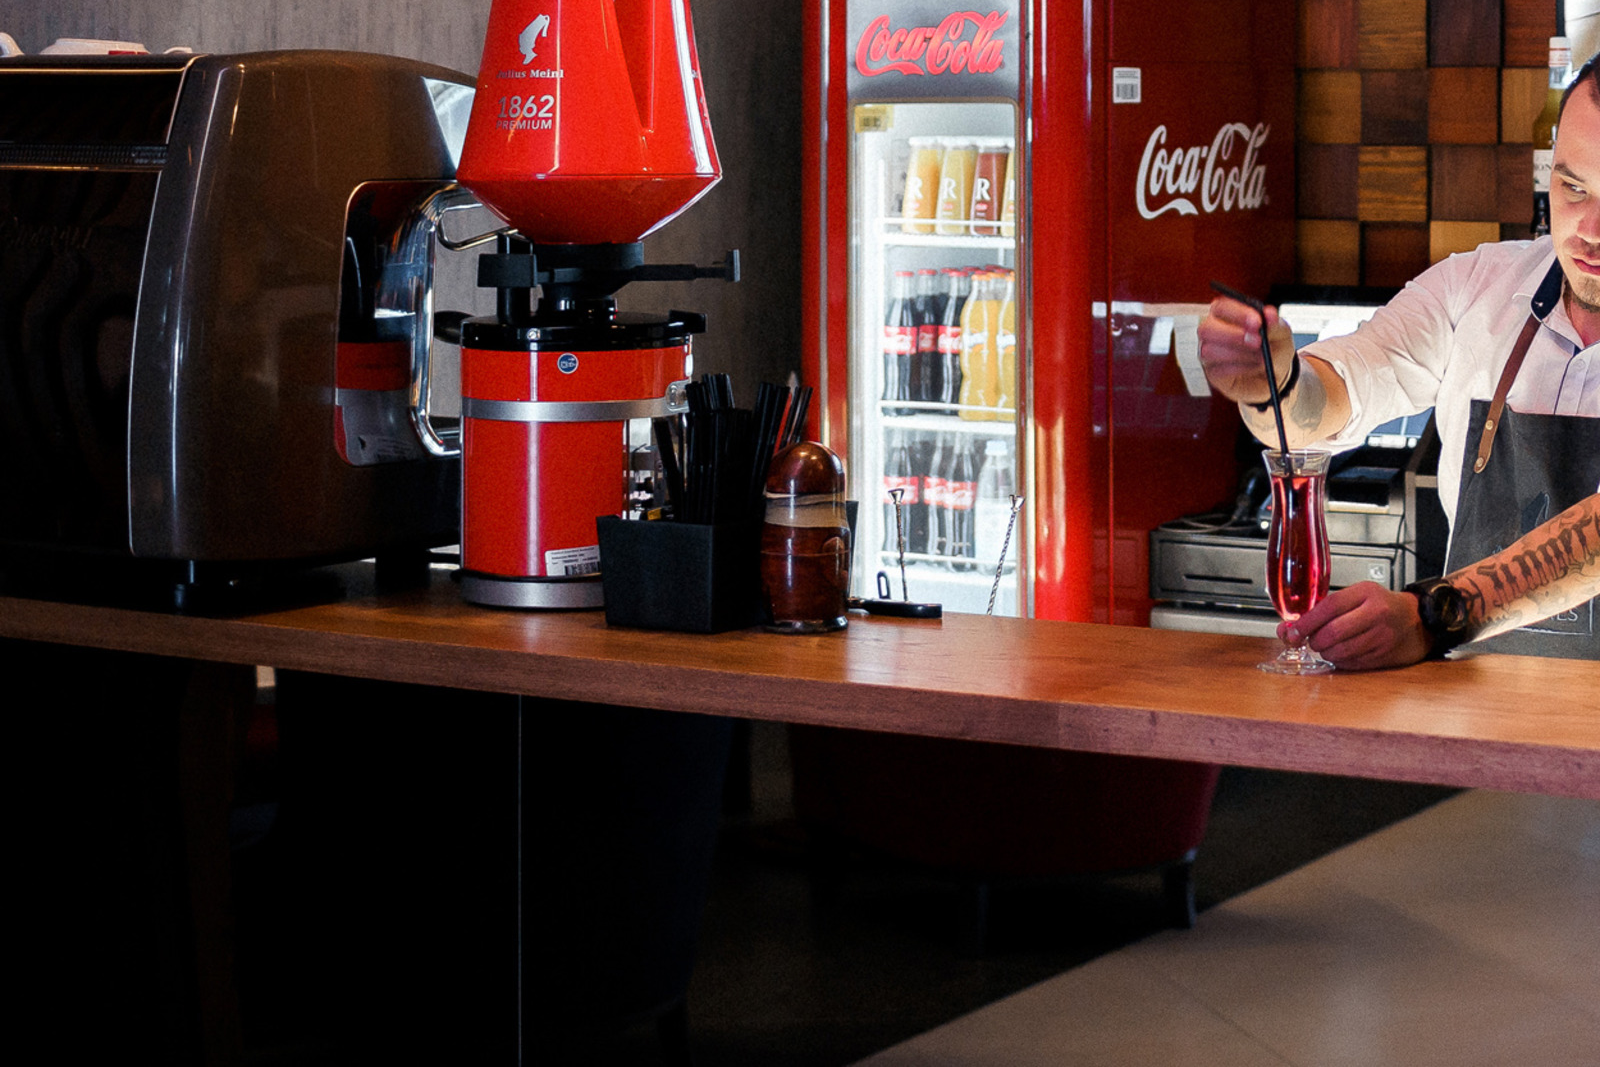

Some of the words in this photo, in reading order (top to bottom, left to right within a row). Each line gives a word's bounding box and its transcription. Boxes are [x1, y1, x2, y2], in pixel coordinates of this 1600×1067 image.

[855, 11, 1009, 76] Coca-Cola
[496, 69, 526, 79] Julius
[529, 68, 564, 79] Meinl
[497, 95, 555, 118] 1862
[496, 119, 553, 130] PREMIUM
[1136, 122, 1270, 219] Coca-Cola
[942, 178, 957, 199] R
[976, 178, 991, 200] R
